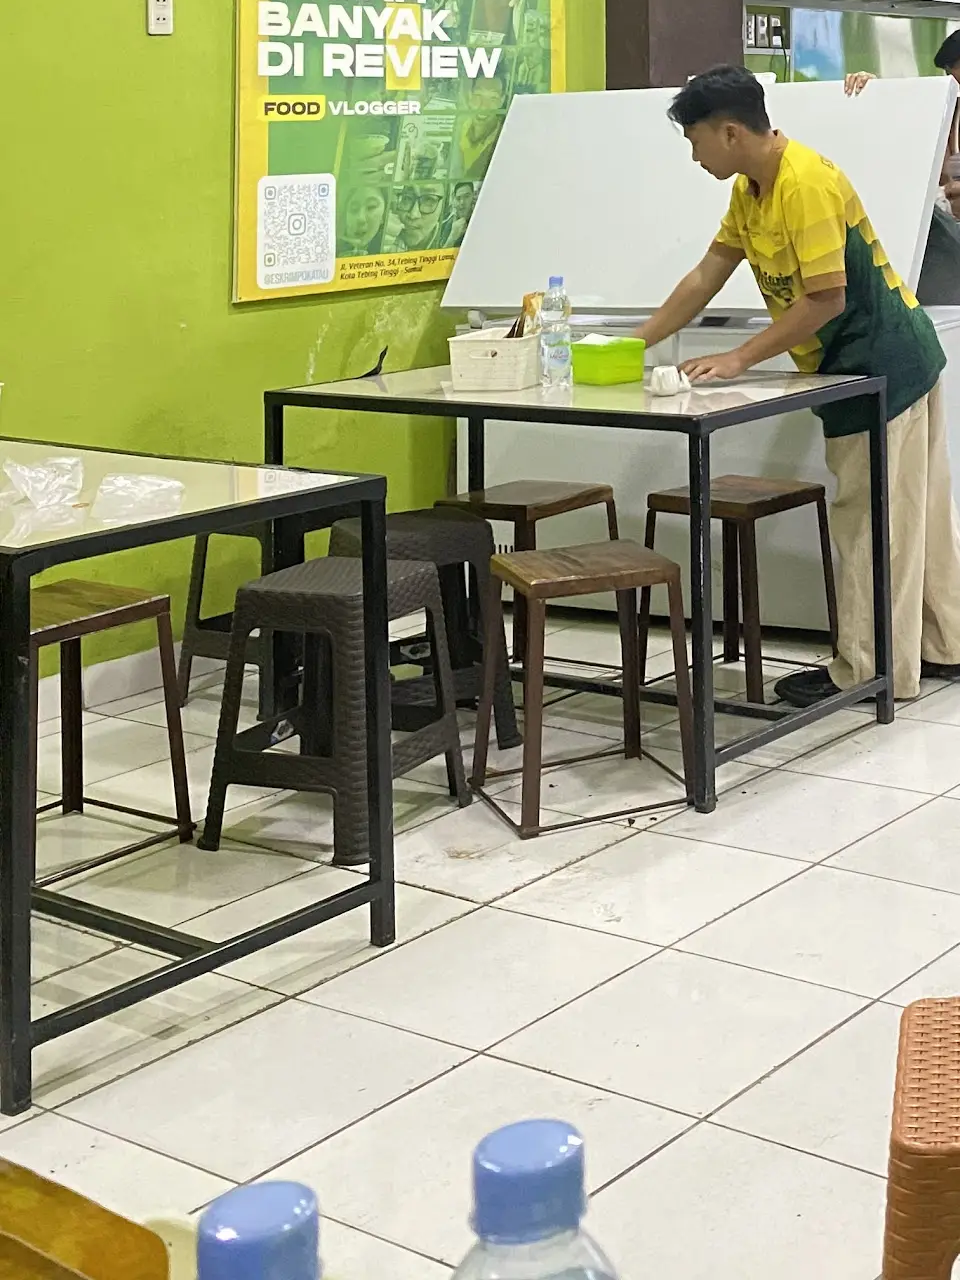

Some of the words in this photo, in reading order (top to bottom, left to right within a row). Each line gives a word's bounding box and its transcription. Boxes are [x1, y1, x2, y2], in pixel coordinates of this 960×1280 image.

[257, 0, 451, 42] BANYAK
[257, 41, 305, 77] DI
[322, 43, 503, 79] REVIEW
[263, 101, 321, 116] FOOD
[327, 100, 421, 116] VLOGGER
[349, 261, 374, 270] Veteran
[375, 260, 386, 268] No.
[340, 272, 355, 281] Kota
